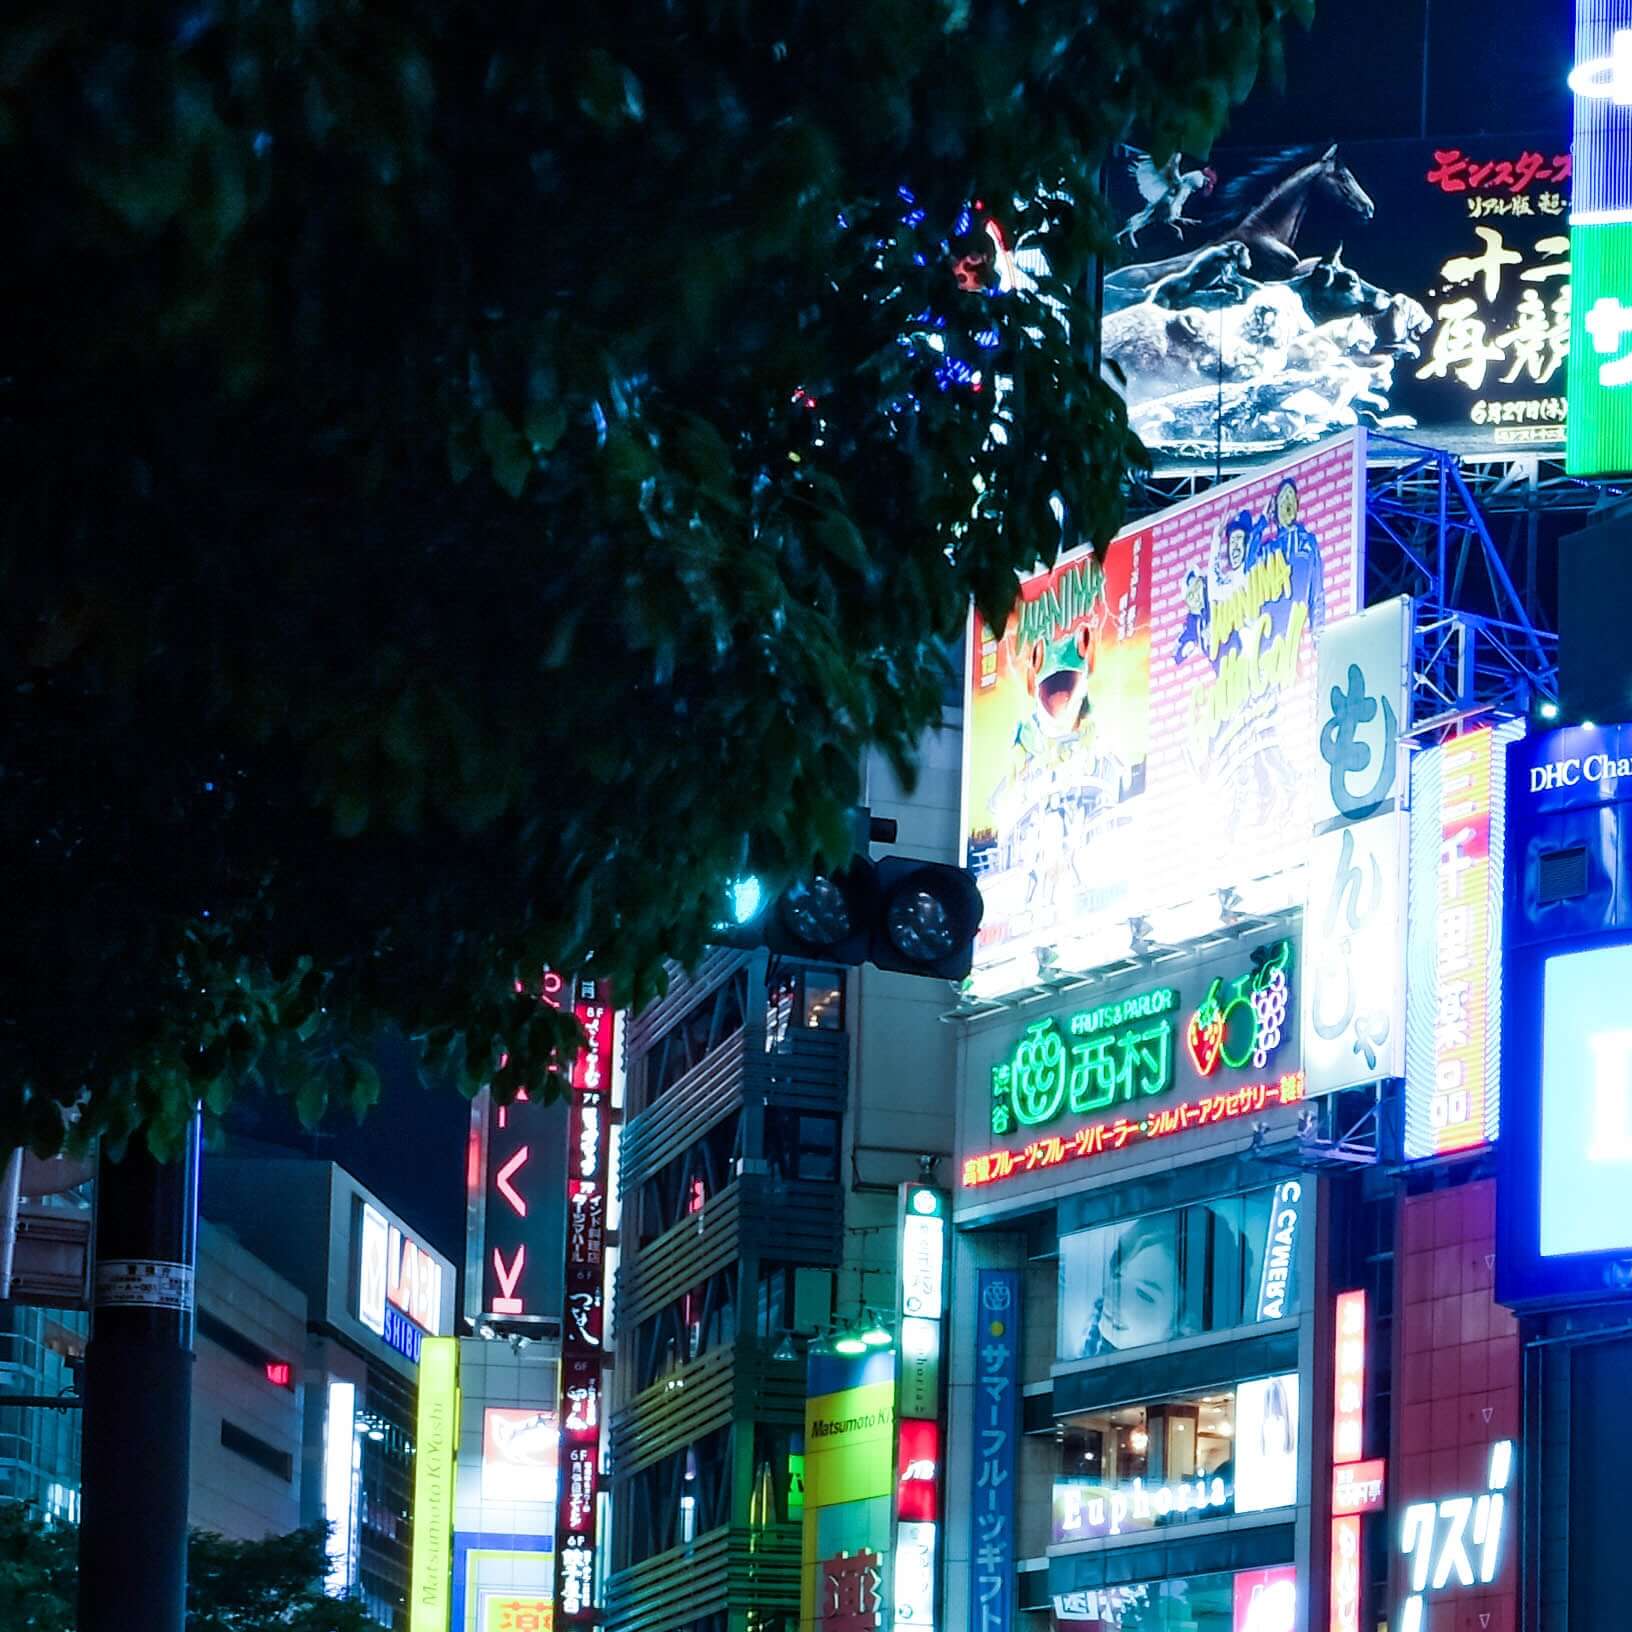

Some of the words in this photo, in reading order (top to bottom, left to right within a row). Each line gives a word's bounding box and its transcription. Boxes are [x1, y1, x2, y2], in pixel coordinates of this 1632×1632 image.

[1529, 758, 1581, 793] DHC
[1068, 1019, 1172, 1114] 西村
[811, 1413, 876, 1438] Matsumoto
[1062, 1470, 1233, 1534] Euphoria
